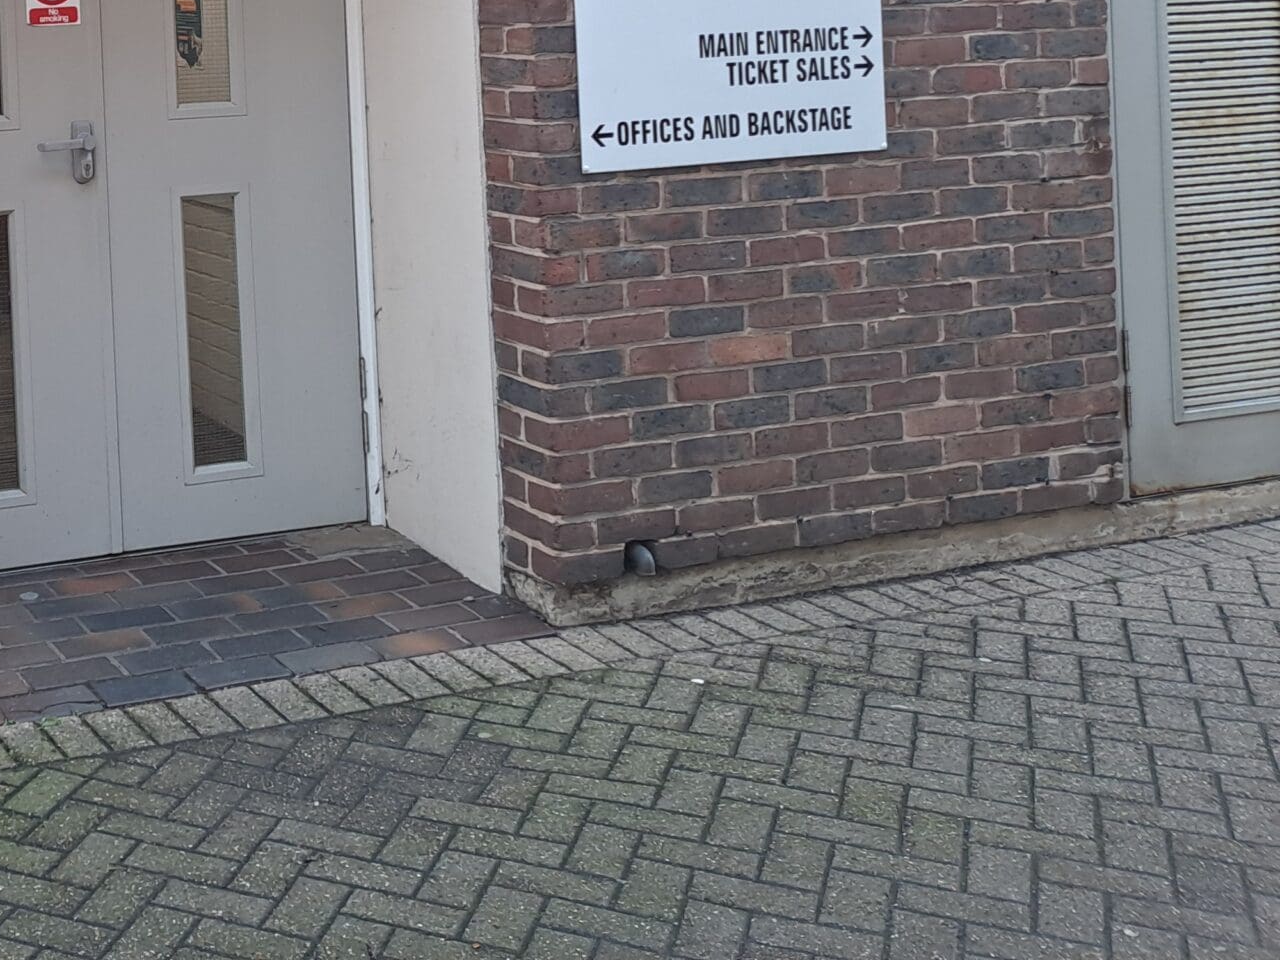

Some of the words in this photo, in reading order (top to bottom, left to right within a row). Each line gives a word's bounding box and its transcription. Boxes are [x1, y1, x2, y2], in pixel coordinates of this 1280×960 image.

[39, 16, 69, 24] smoking
[48, 8, 59, 16] No
[699, 31, 749, 59] MAIN
[755, 26, 850, 55] ENTRANCE
[726, 58, 790, 87] TICKET
[796, 55, 852, 83] SALES
[616, 117, 695, 146] OFFICES
[700, 114, 740, 140] AND
[747, 106, 853, 137] BACKSTAGE
